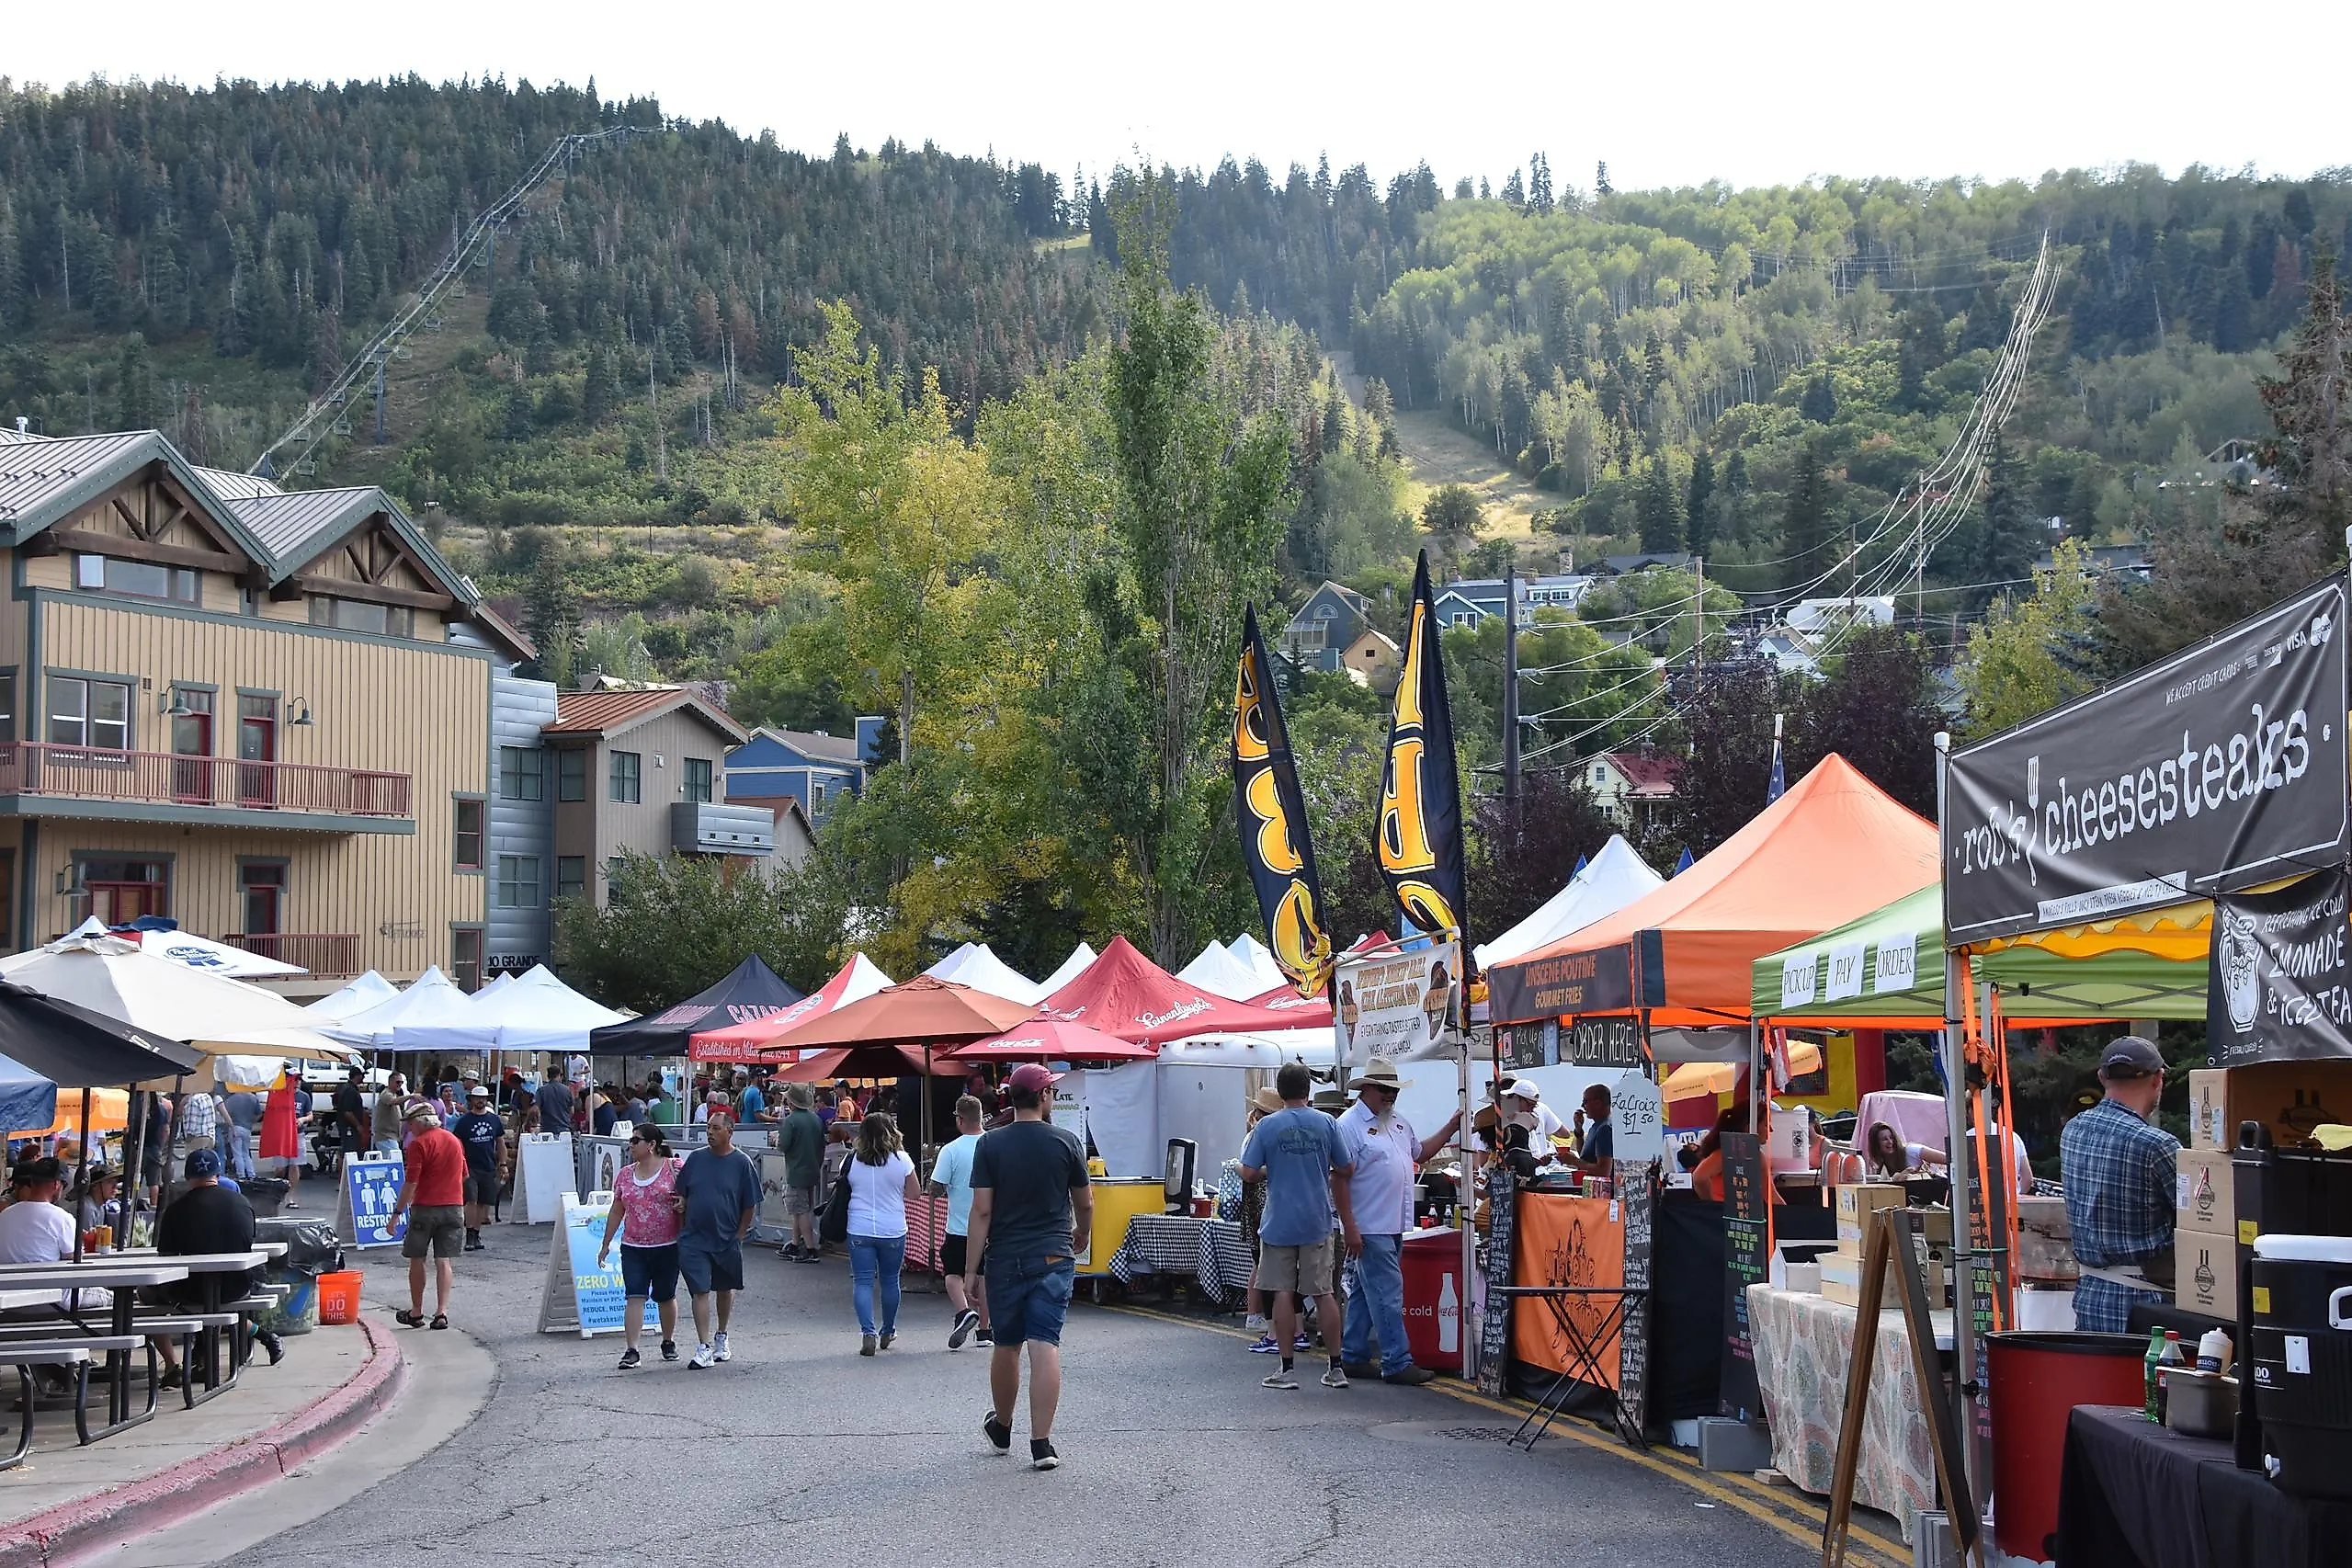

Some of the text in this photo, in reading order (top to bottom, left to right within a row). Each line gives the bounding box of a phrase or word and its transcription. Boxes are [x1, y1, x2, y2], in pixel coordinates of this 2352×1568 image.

[2286, 631, 2307, 653] VISA
[2165, 688, 2175, 706] WE
[2174, 679, 2198, 701] ACCEPT
[2198, 671, 2218, 692] CREDIT
[1962, 703, 2309, 875] rob's cheesesteaks
[2261, 894, 2344, 935] REFRESHING ICE COLD
[502, 955, 540, 966] GRANDE
[1526, 955, 1596, 987] UNSCENE POUTINE
[1835, 955, 1856, 985] PAY
[1877, 946, 1912, 978] ORDER
[1535, 985, 1583, 1008] GOURMET FRIES
[2267, 987, 2278, 1015] &
[2316, 985, 2352, 1028] TEA
[696, 1040, 733, 1060] Established
[733, 1042, 741, 1059] in
[1573, 1022, 1604, 1062] ORDER
[358, 1212, 407, 1228] RESTROM
[576, 1276, 608, 1290] ZERO
[591, 1289, 608, 1297] Please
[327, 1299, 346, 1312] DO
[327, 1312, 347, 1321] THIS.
[1410, 1305, 1432, 1316] cold
